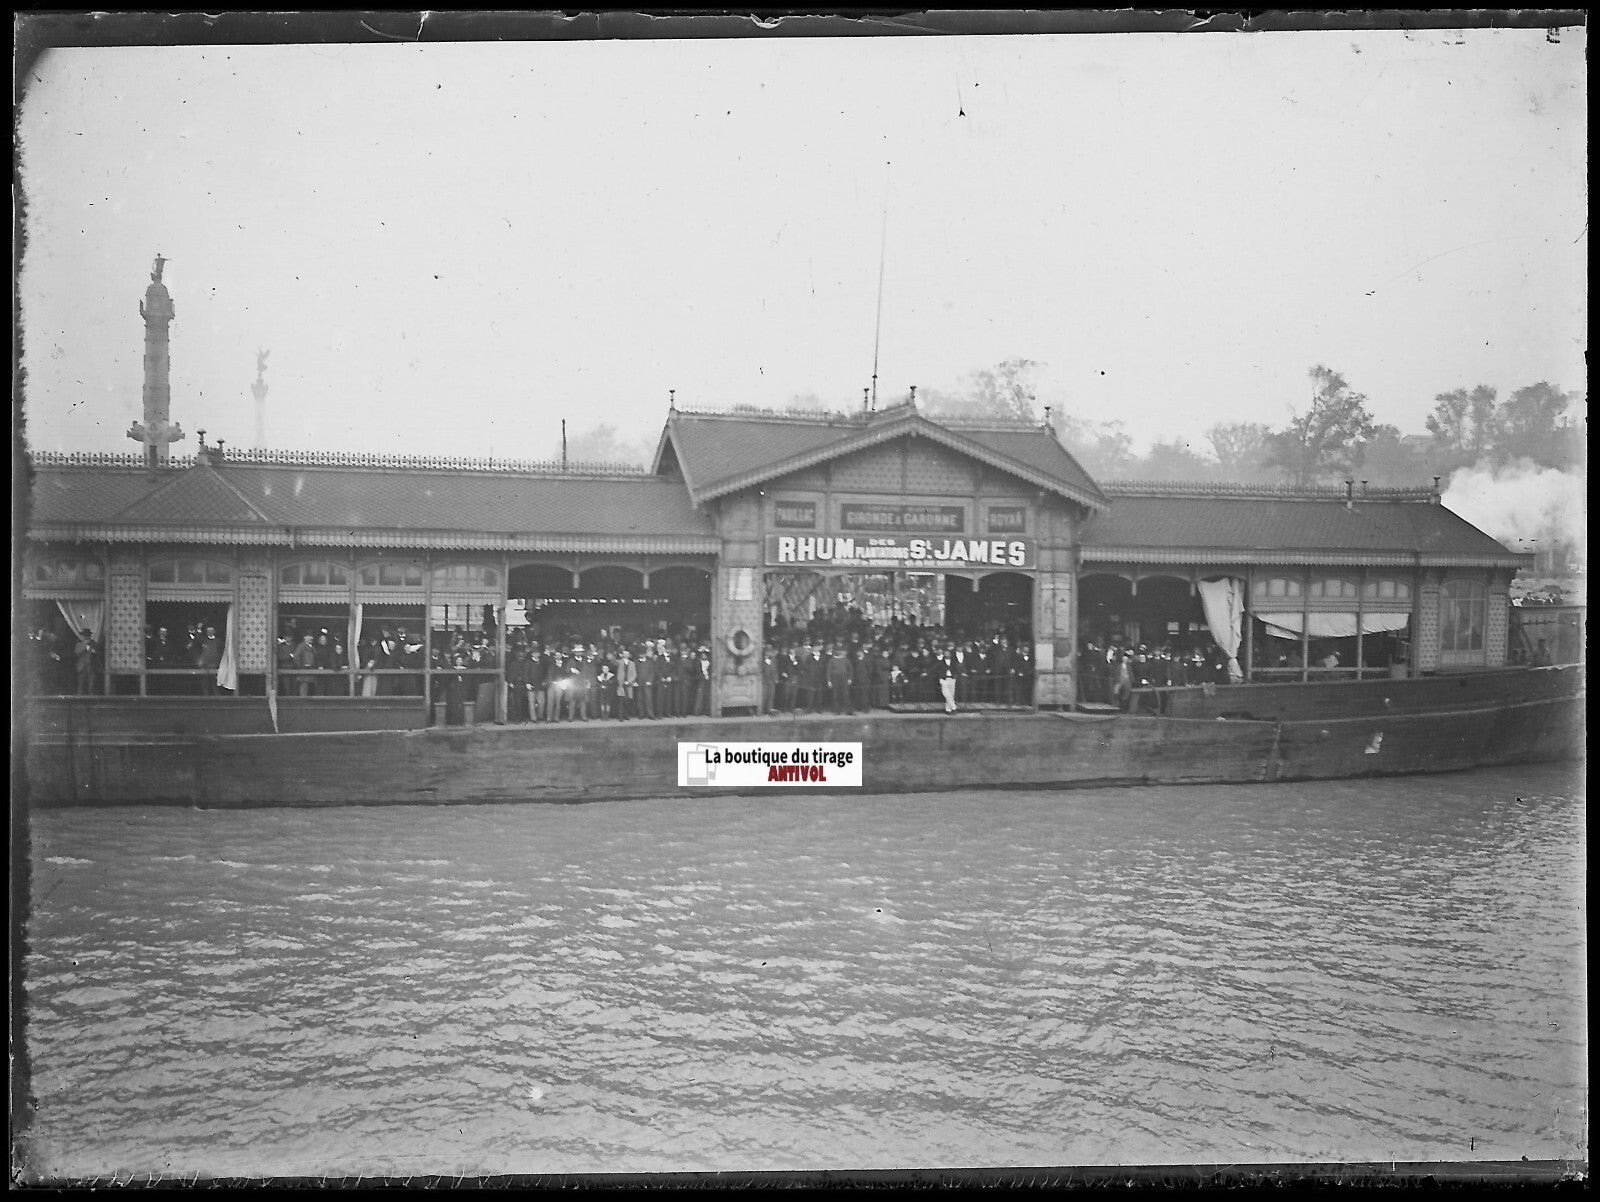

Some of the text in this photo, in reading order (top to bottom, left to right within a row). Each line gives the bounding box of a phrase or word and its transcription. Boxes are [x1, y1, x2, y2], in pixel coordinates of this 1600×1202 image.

[903, 513, 958, 526] GARONNE
[778, 537, 854, 562] RHUM
[934, 539, 1026, 567] JAMES
